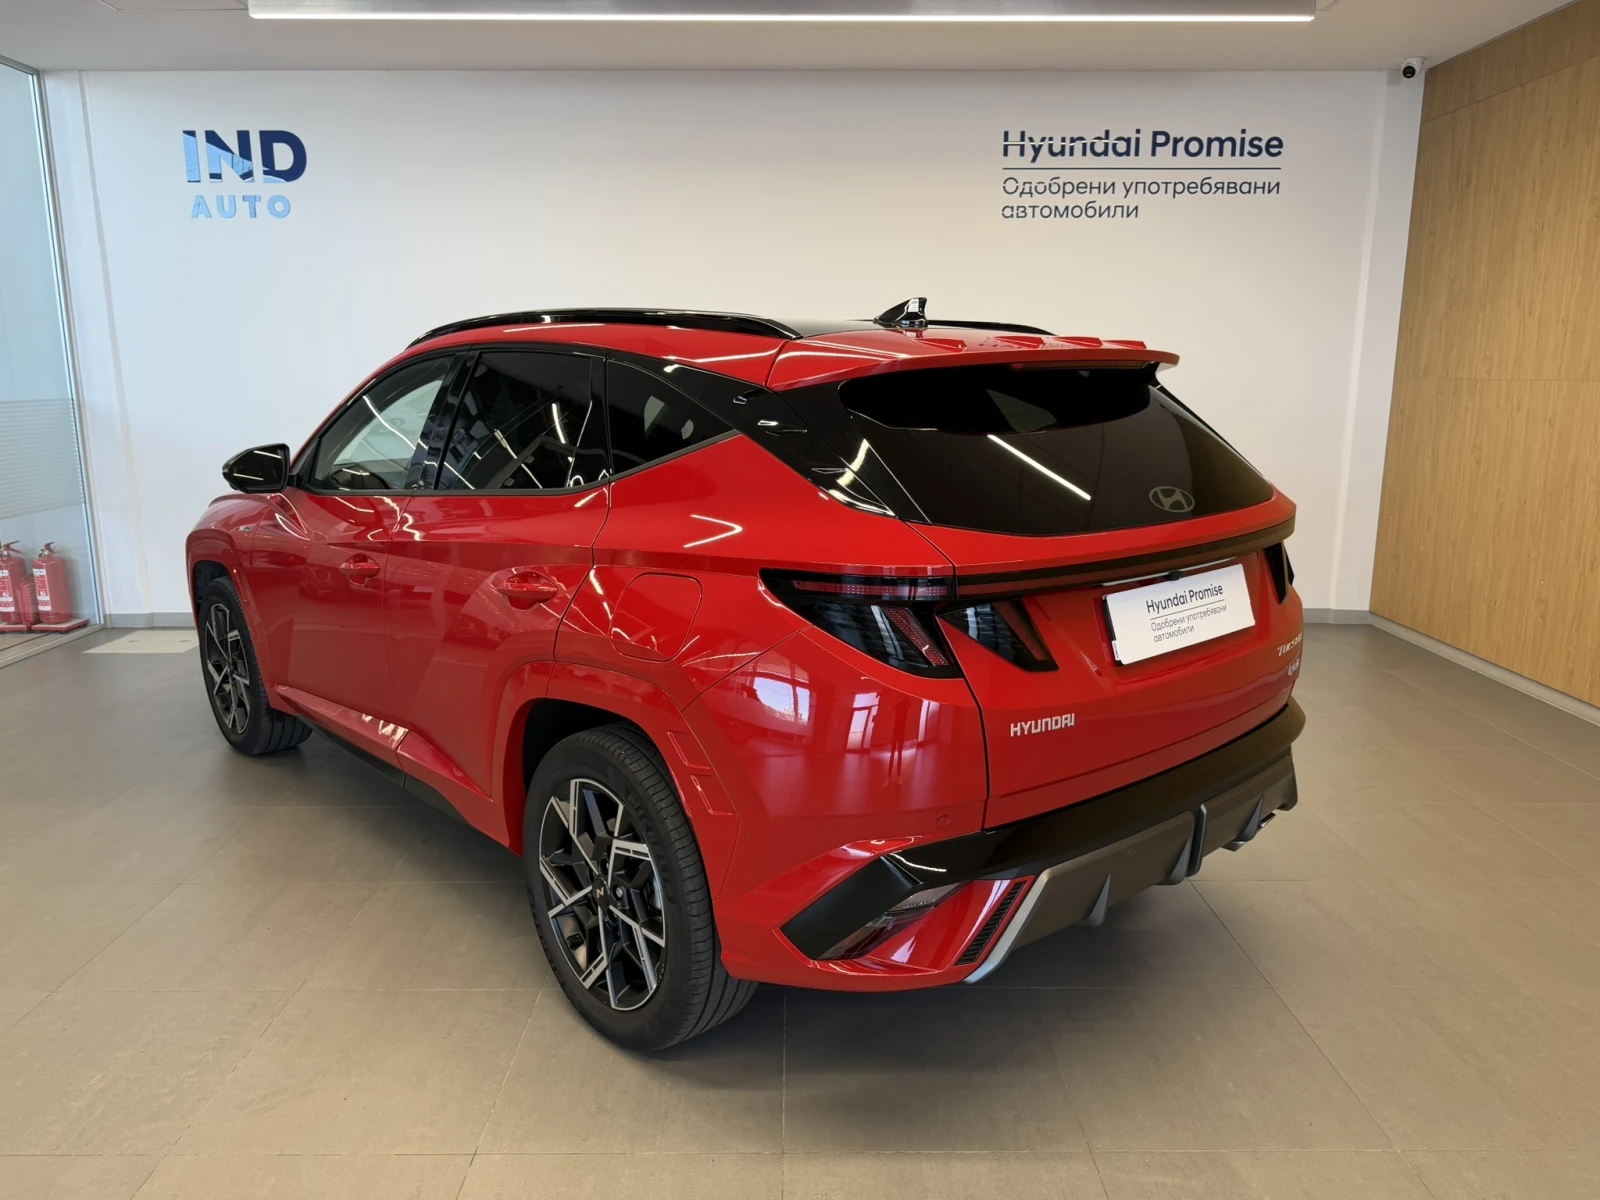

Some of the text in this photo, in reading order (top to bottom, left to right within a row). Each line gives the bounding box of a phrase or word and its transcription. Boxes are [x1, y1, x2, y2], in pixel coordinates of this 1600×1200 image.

[182, 130, 307, 183] IND
[1003, 128, 1284, 163] Hyundai Promise
[1002, 176, 1281, 199] Одобрени употребявани
[190, 194, 291, 218] AUTO
[1001, 200, 1139, 219] автомобили
[1146, 584, 1224, 614] Hyundai Promise
[1151, 605, 1228, 632] Одобрени употребявани
[1153, 625, 1195, 643] автомобили
[1010, 713, 1075, 737] HYUNDAI
